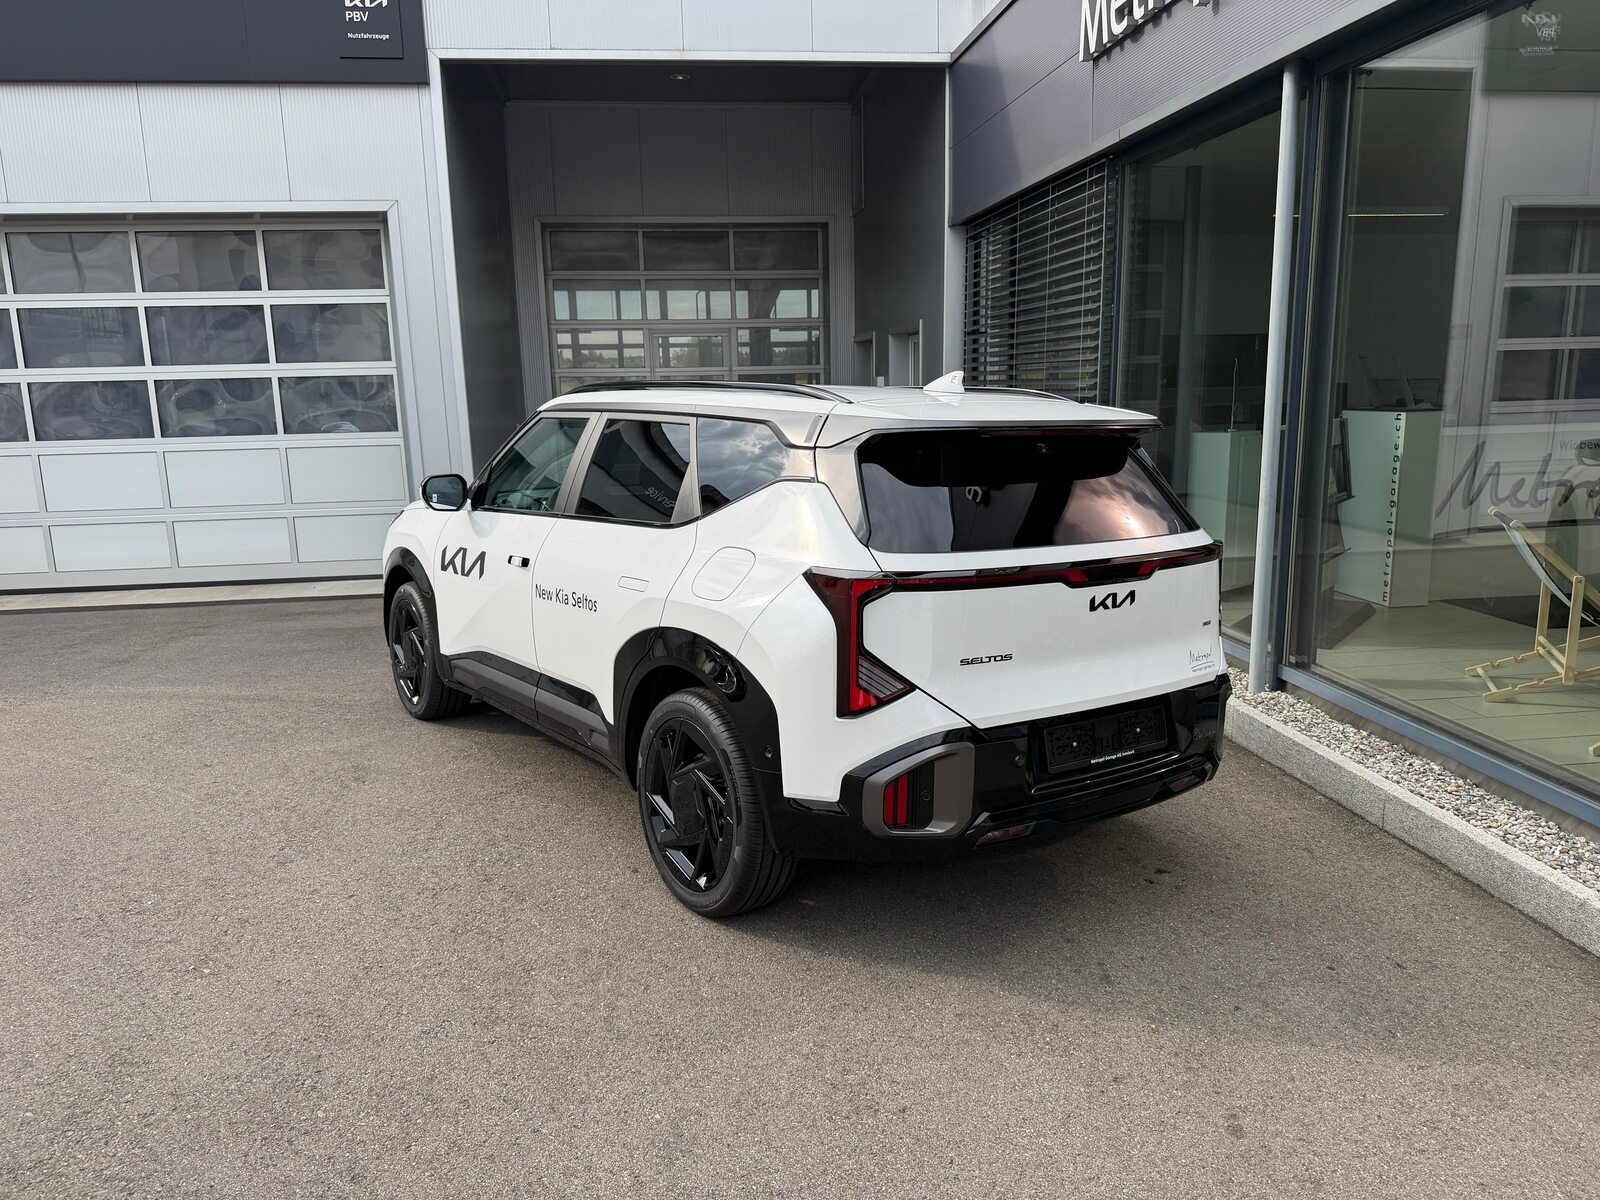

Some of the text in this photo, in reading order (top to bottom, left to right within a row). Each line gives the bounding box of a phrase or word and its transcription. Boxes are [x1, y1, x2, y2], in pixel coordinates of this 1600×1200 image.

[345, 11, 369, 22] PBV
[347, 32, 390, 40] Nutzfahrzeuge
[1382, 413, 1402, 602] metropol-garage.ch
[440, 544, 487, 581] KIA
[535, 583, 598, 613] New Kia Seltos
[1089, 589, 1136, 612] KIA
[959, 653, 1013, 666] SELTOS
